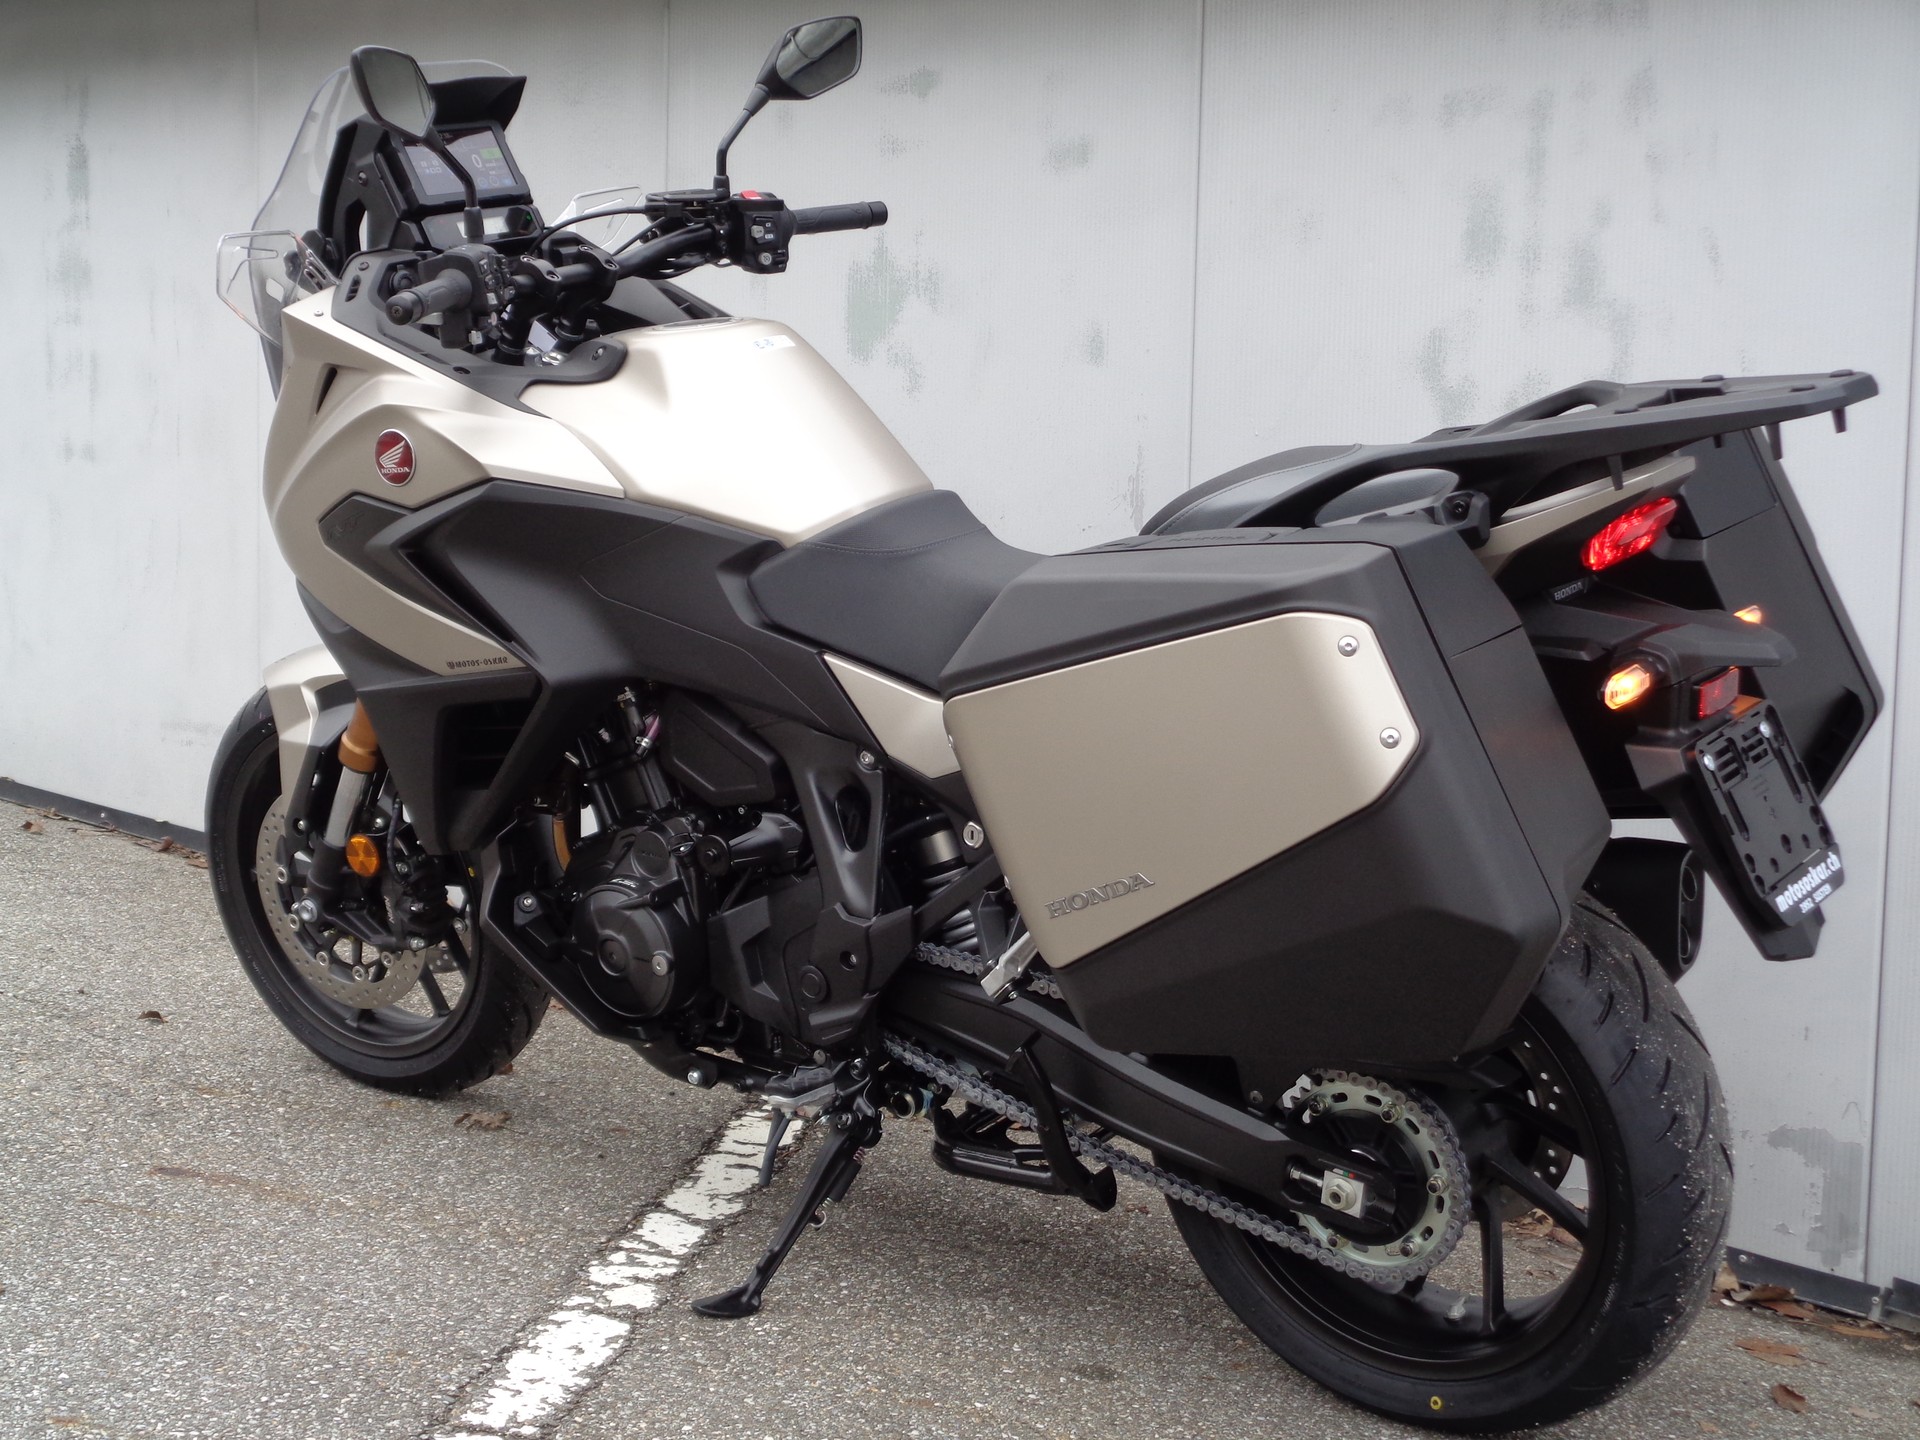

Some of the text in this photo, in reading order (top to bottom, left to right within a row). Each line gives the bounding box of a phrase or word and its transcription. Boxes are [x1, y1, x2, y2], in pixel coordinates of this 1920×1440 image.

[381, 466, 411, 474] HONDA
[1554, 581, 1584, 600] HONDA
[455, 656, 508, 668] MOTOS-OSKAR
[1775, 851, 1841, 913] motososkar.ch
[1044, 872, 1155, 919] HONDA
